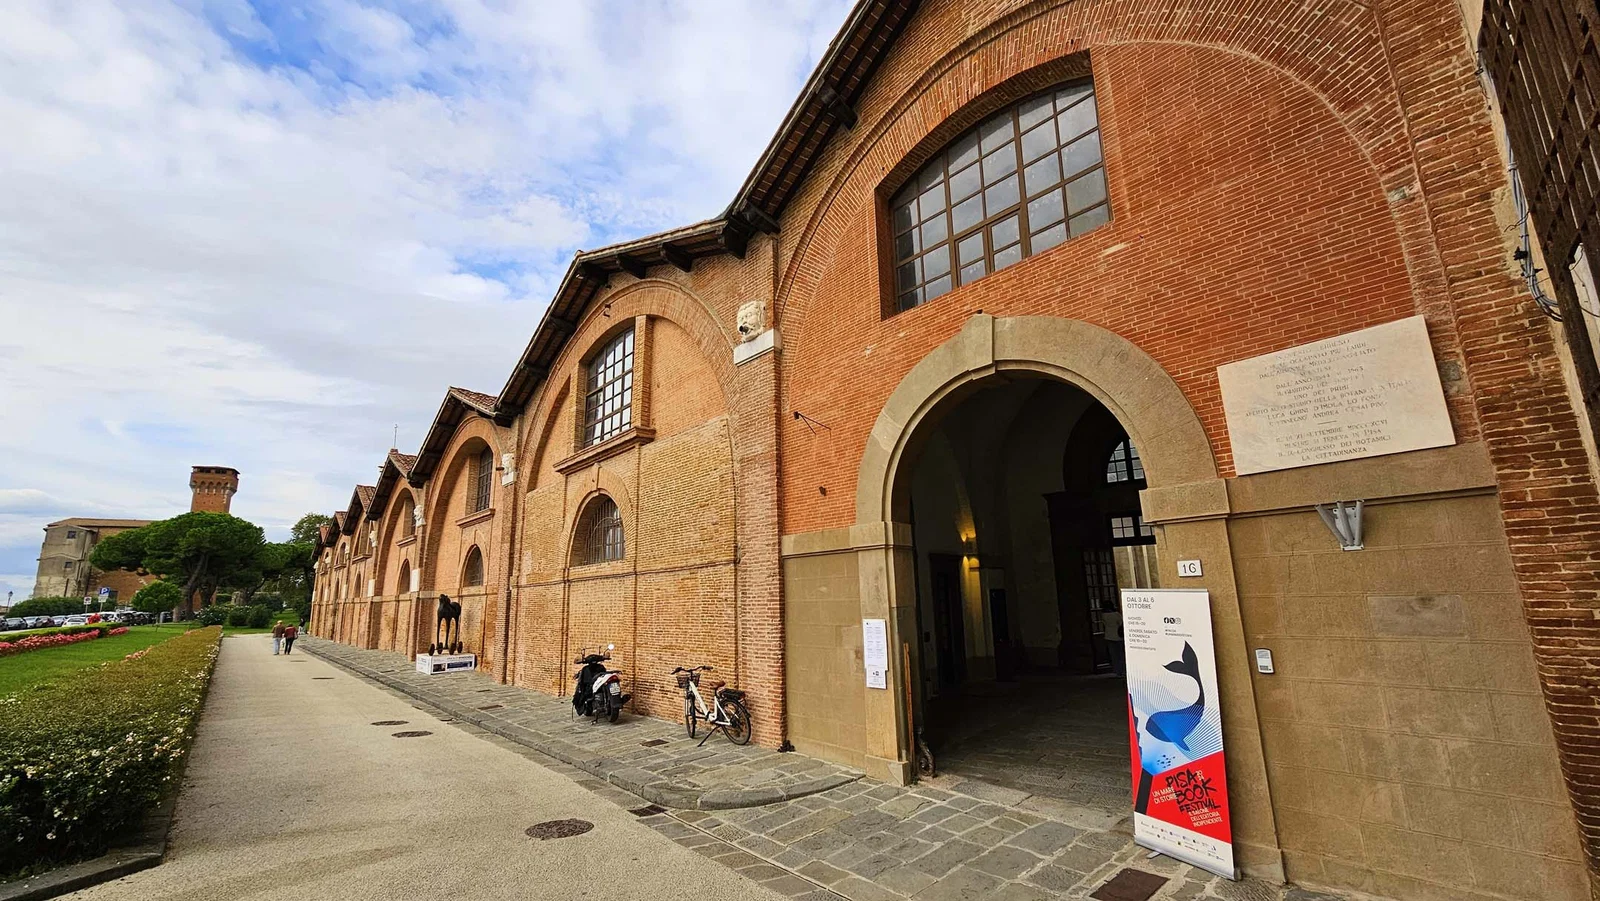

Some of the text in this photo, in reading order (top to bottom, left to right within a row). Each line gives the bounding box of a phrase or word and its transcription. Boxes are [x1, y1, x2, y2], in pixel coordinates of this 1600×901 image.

[1315, 446, 1368, 459] CITTADINANZA
[1166, 768, 1198, 788] PISA
[1152, 787, 1174, 798] UN MARE
[1174, 778, 1216, 805] BOOK
[1179, 798, 1221, 813] FESTIVAL
[1193, 816, 1223, 827] INDIPENDENTE
